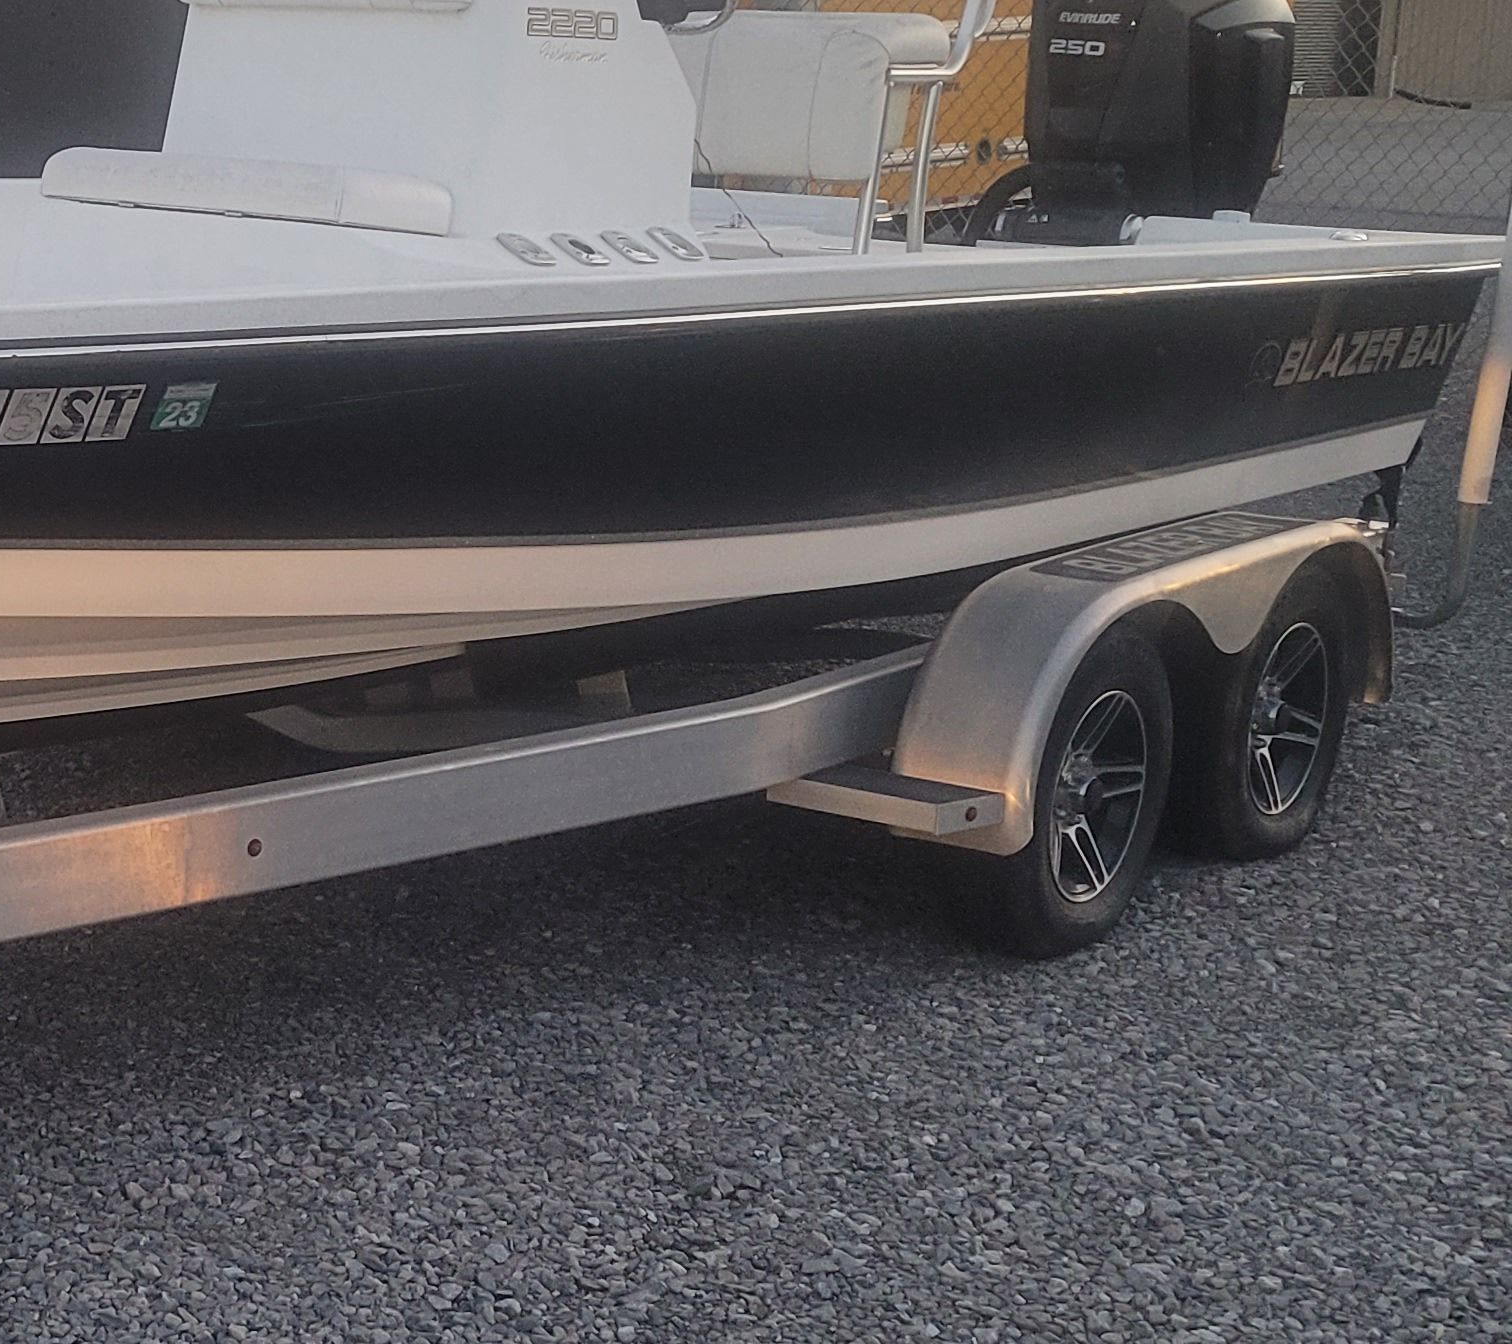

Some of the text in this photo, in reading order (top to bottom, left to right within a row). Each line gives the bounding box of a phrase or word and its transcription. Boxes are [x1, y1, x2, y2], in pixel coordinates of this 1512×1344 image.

[527, 7, 618, 40] 2220
[1058, 11, 1122, 25] EVINRUDE
[1049, 39, 1106, 56] 250
[1273, 322, 1467, 388] BLAZER BAY
[159, 401, 201, 428] 23
